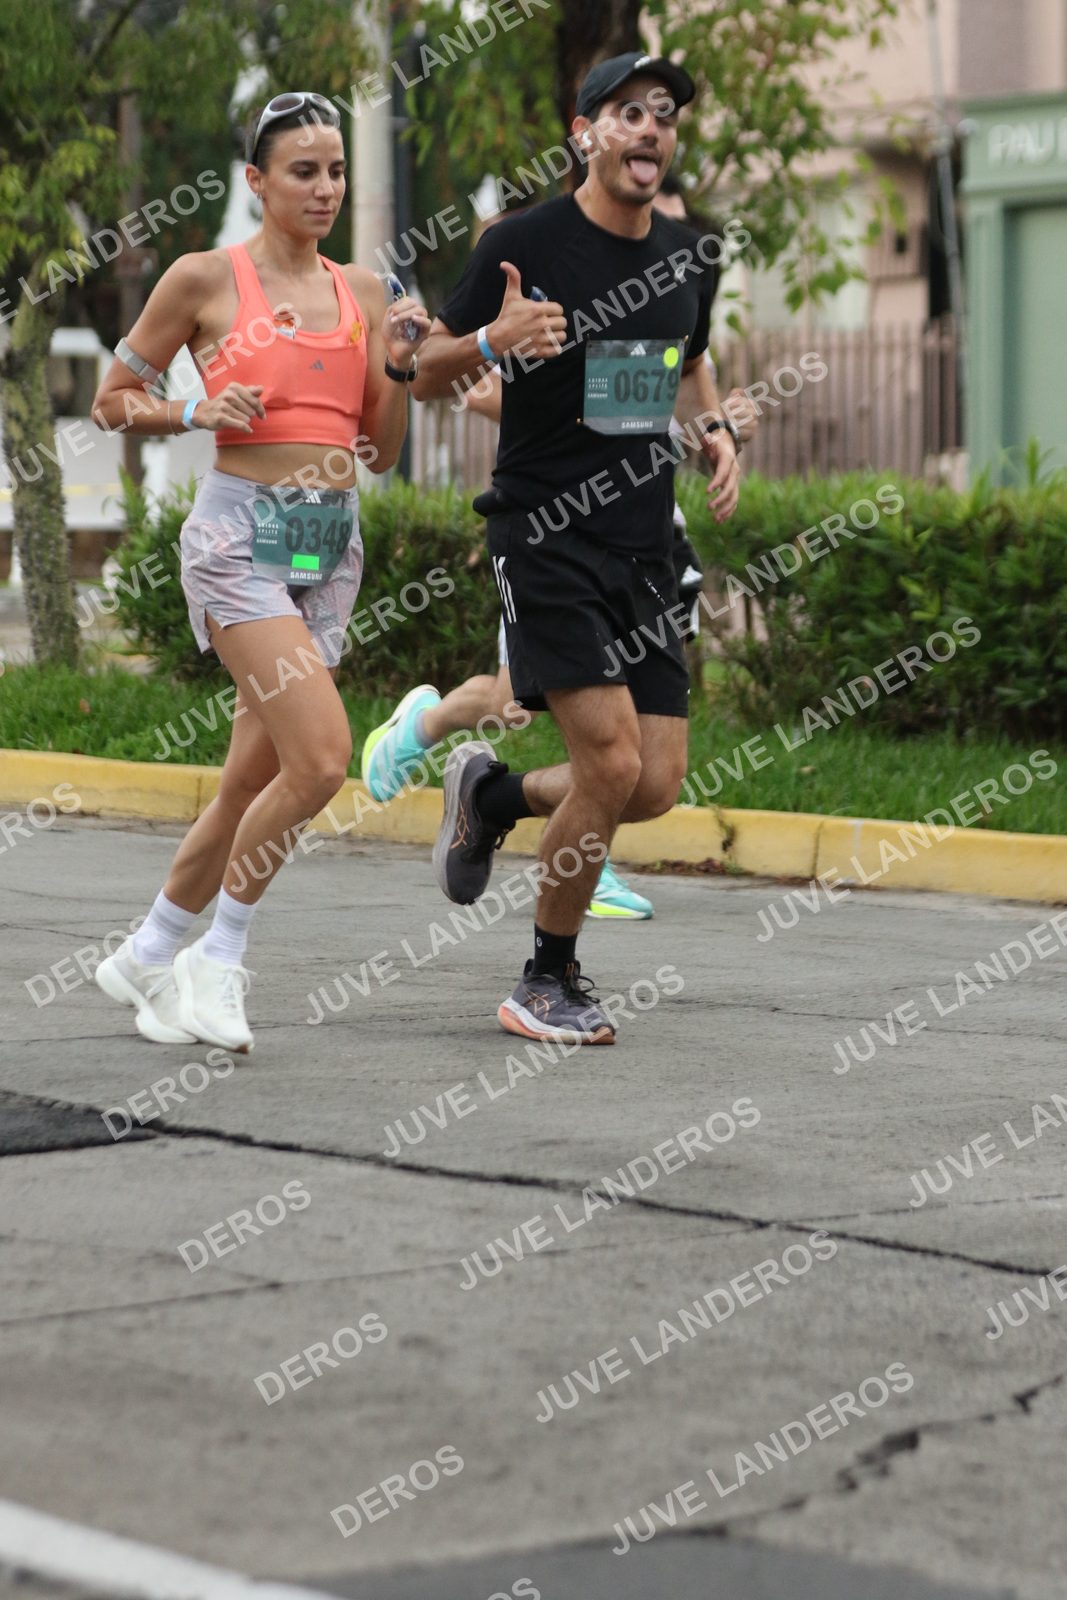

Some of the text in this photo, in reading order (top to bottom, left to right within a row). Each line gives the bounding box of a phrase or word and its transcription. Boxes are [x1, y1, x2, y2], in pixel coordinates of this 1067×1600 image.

[987, 118, 1067, 166] PAU
[614, 368, 679, 403] 0679
[621, 421, 653, 429] SAMSUNG
[284, 516, 350, 554] 0348
